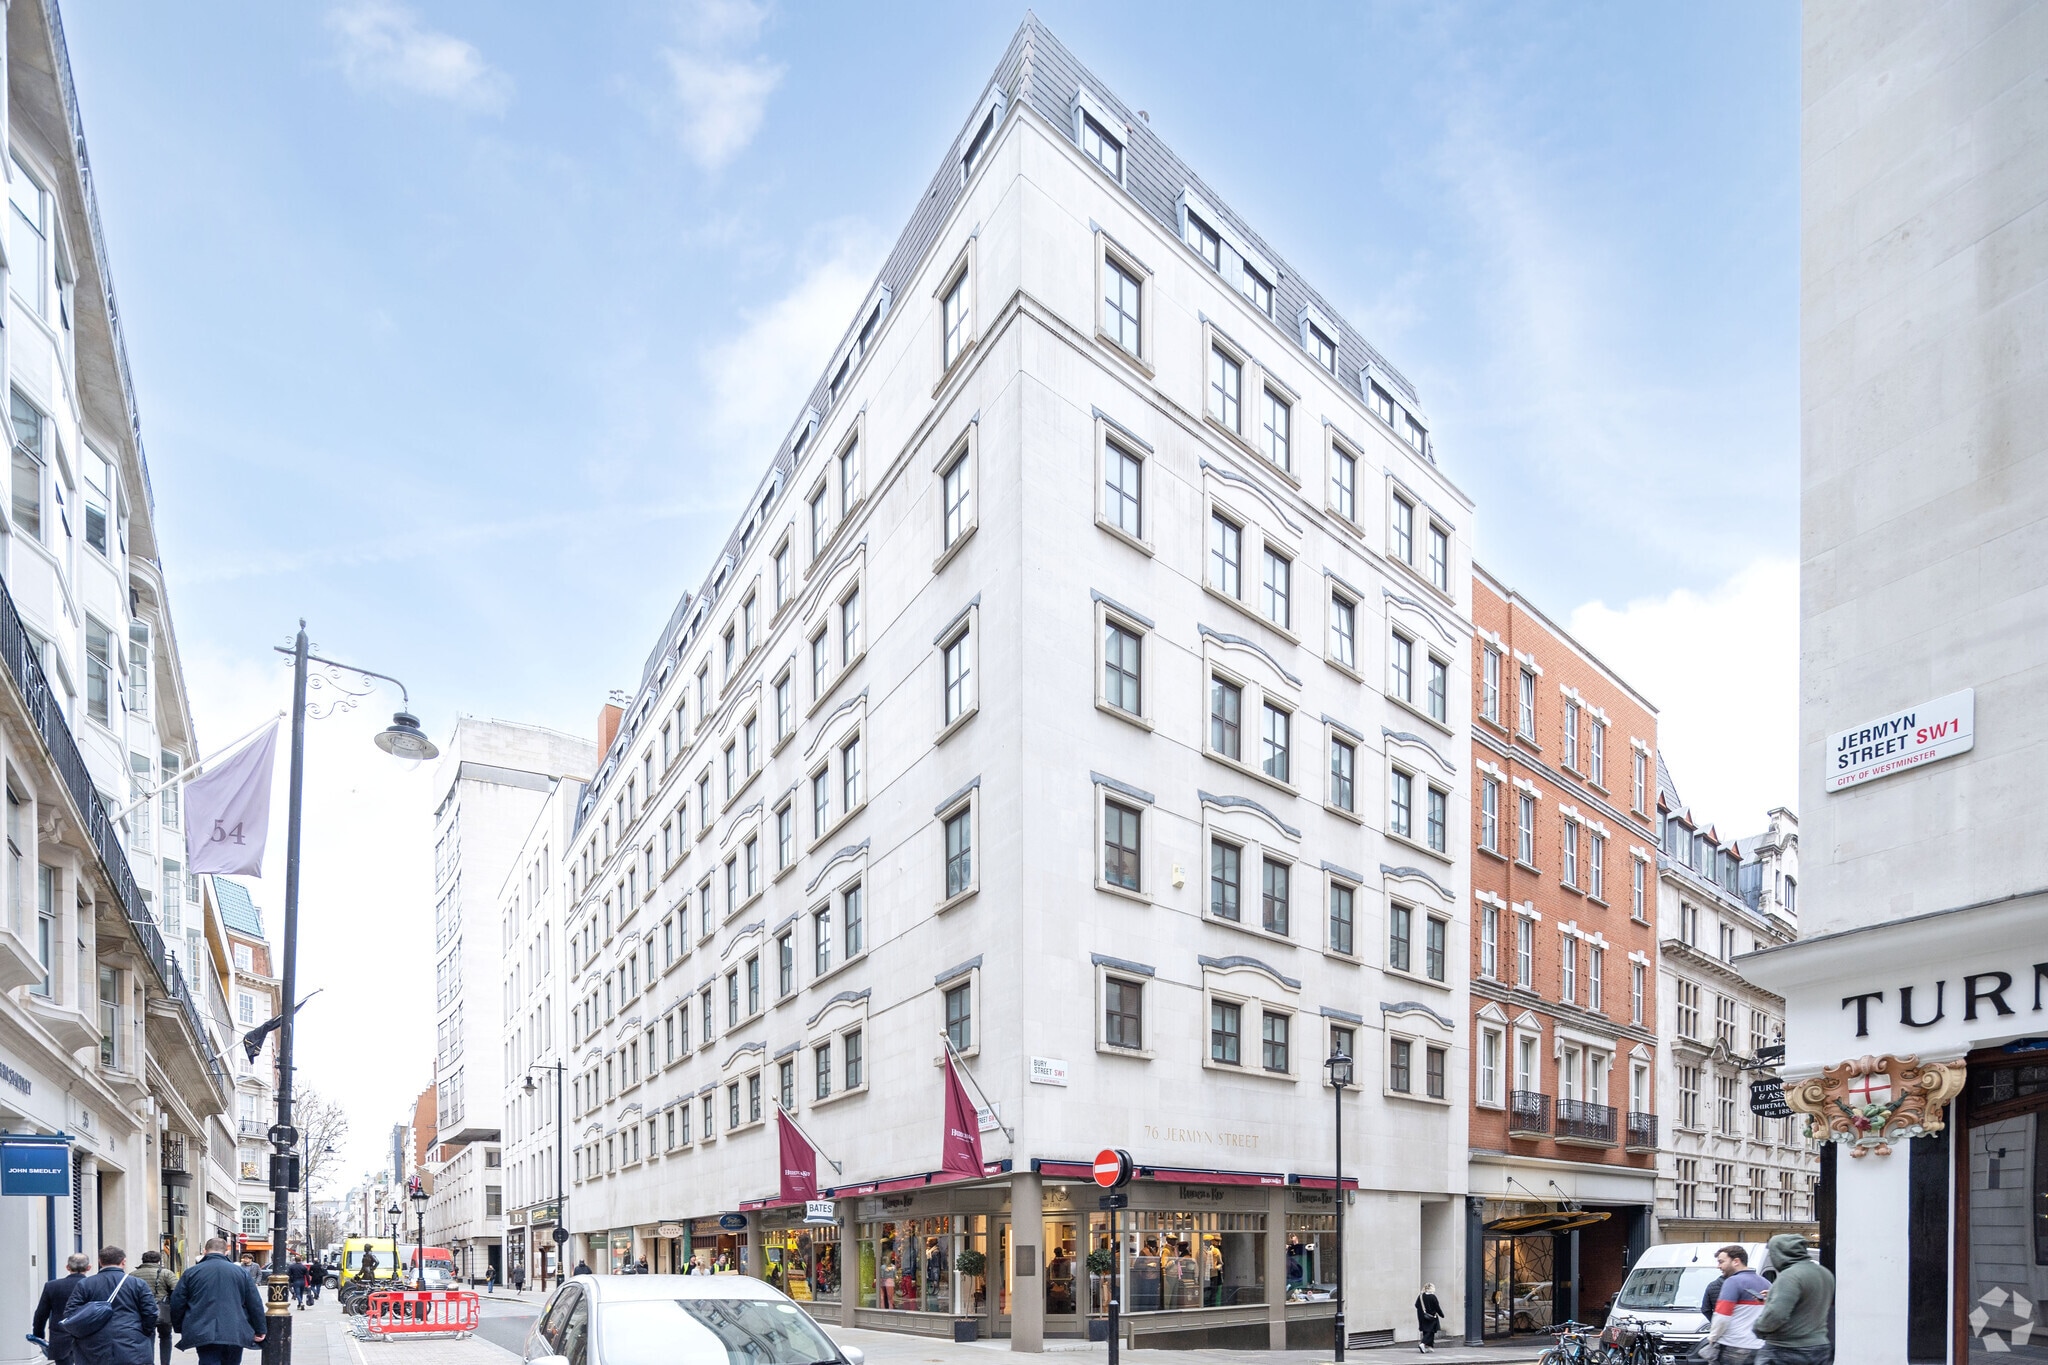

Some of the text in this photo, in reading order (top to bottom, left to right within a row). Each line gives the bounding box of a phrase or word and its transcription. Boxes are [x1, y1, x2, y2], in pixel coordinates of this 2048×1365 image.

[1838, 713, 1916, 752] JERMYN
[1838, 718, 1959, 770] STREET SW1
[1837, 750, 1936, 786] CITY OF WESTMINSTER
[210, 819, 246, 846] 54
[1034, 1059, 1047, 1068] BURY
[1034, 1066, 1052, 1076] STREET
[1144, 1125, 1259, 1148] 76 JERMYN STREET
[1051, 1188, 1071, 1202] Key
[809, 1203, 832, 1213] BATES
[514, 1213, 523, 1223] B
